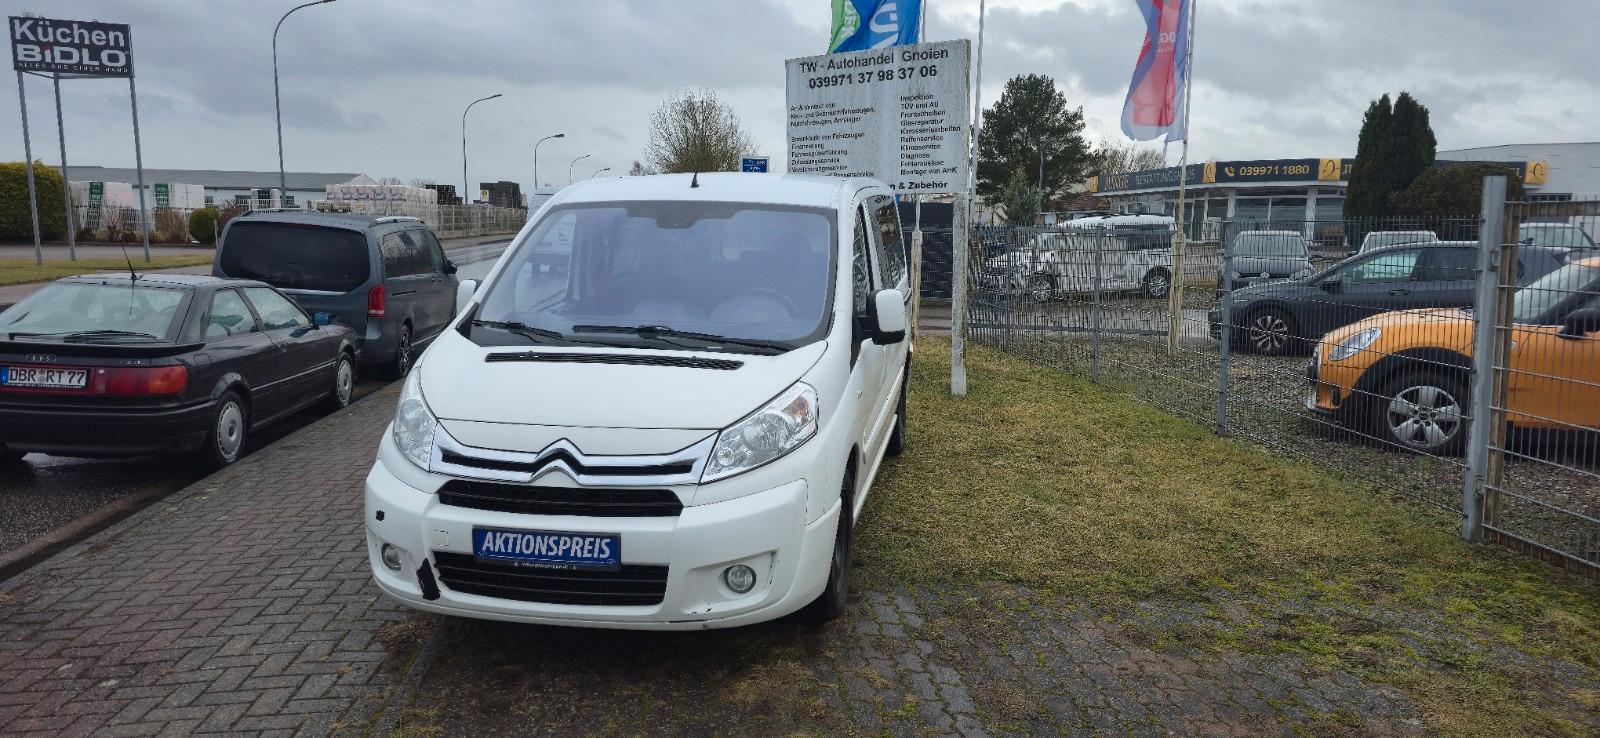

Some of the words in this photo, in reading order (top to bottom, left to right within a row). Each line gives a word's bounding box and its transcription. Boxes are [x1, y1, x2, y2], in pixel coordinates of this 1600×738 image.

[14, 19, 125, 47] Küchen
[799, 61, 817, 73] TW
[828, 53, 894, 71] Autohandel
[902, 48, 948, 62] Gnoien
[809, 74, 852, 89] 039971
[858, 71, 874, 84] 37
[877, 69, 895, 82] 98
[899, 66, 915, 80] 37
[920, 64, 938, 78] 06
[900, 94, 934, 103] Inspektion
[900, 110, 946, 119] Frontscheiben
[900, 119, 944, 127] Glasreparatur
[900, 126, 961, 135] Karosseriearbeiten
[832, 132, 865, 140] Fahrzeugen
[942, 166, 958, 174] AHK
[1239, 166, 1279, 177] 039971
[1282, 165, 1310, 175] 1880
[898, 182, 906, 190] &
[908, 181, 949, 190] Zubehör
[9, 367, 36, 381] DBR
[45, 369, 64, 383] RT
[67, 370, 85, 384] 77
[482, 531, 610, 559] AKTIONSPREIS
